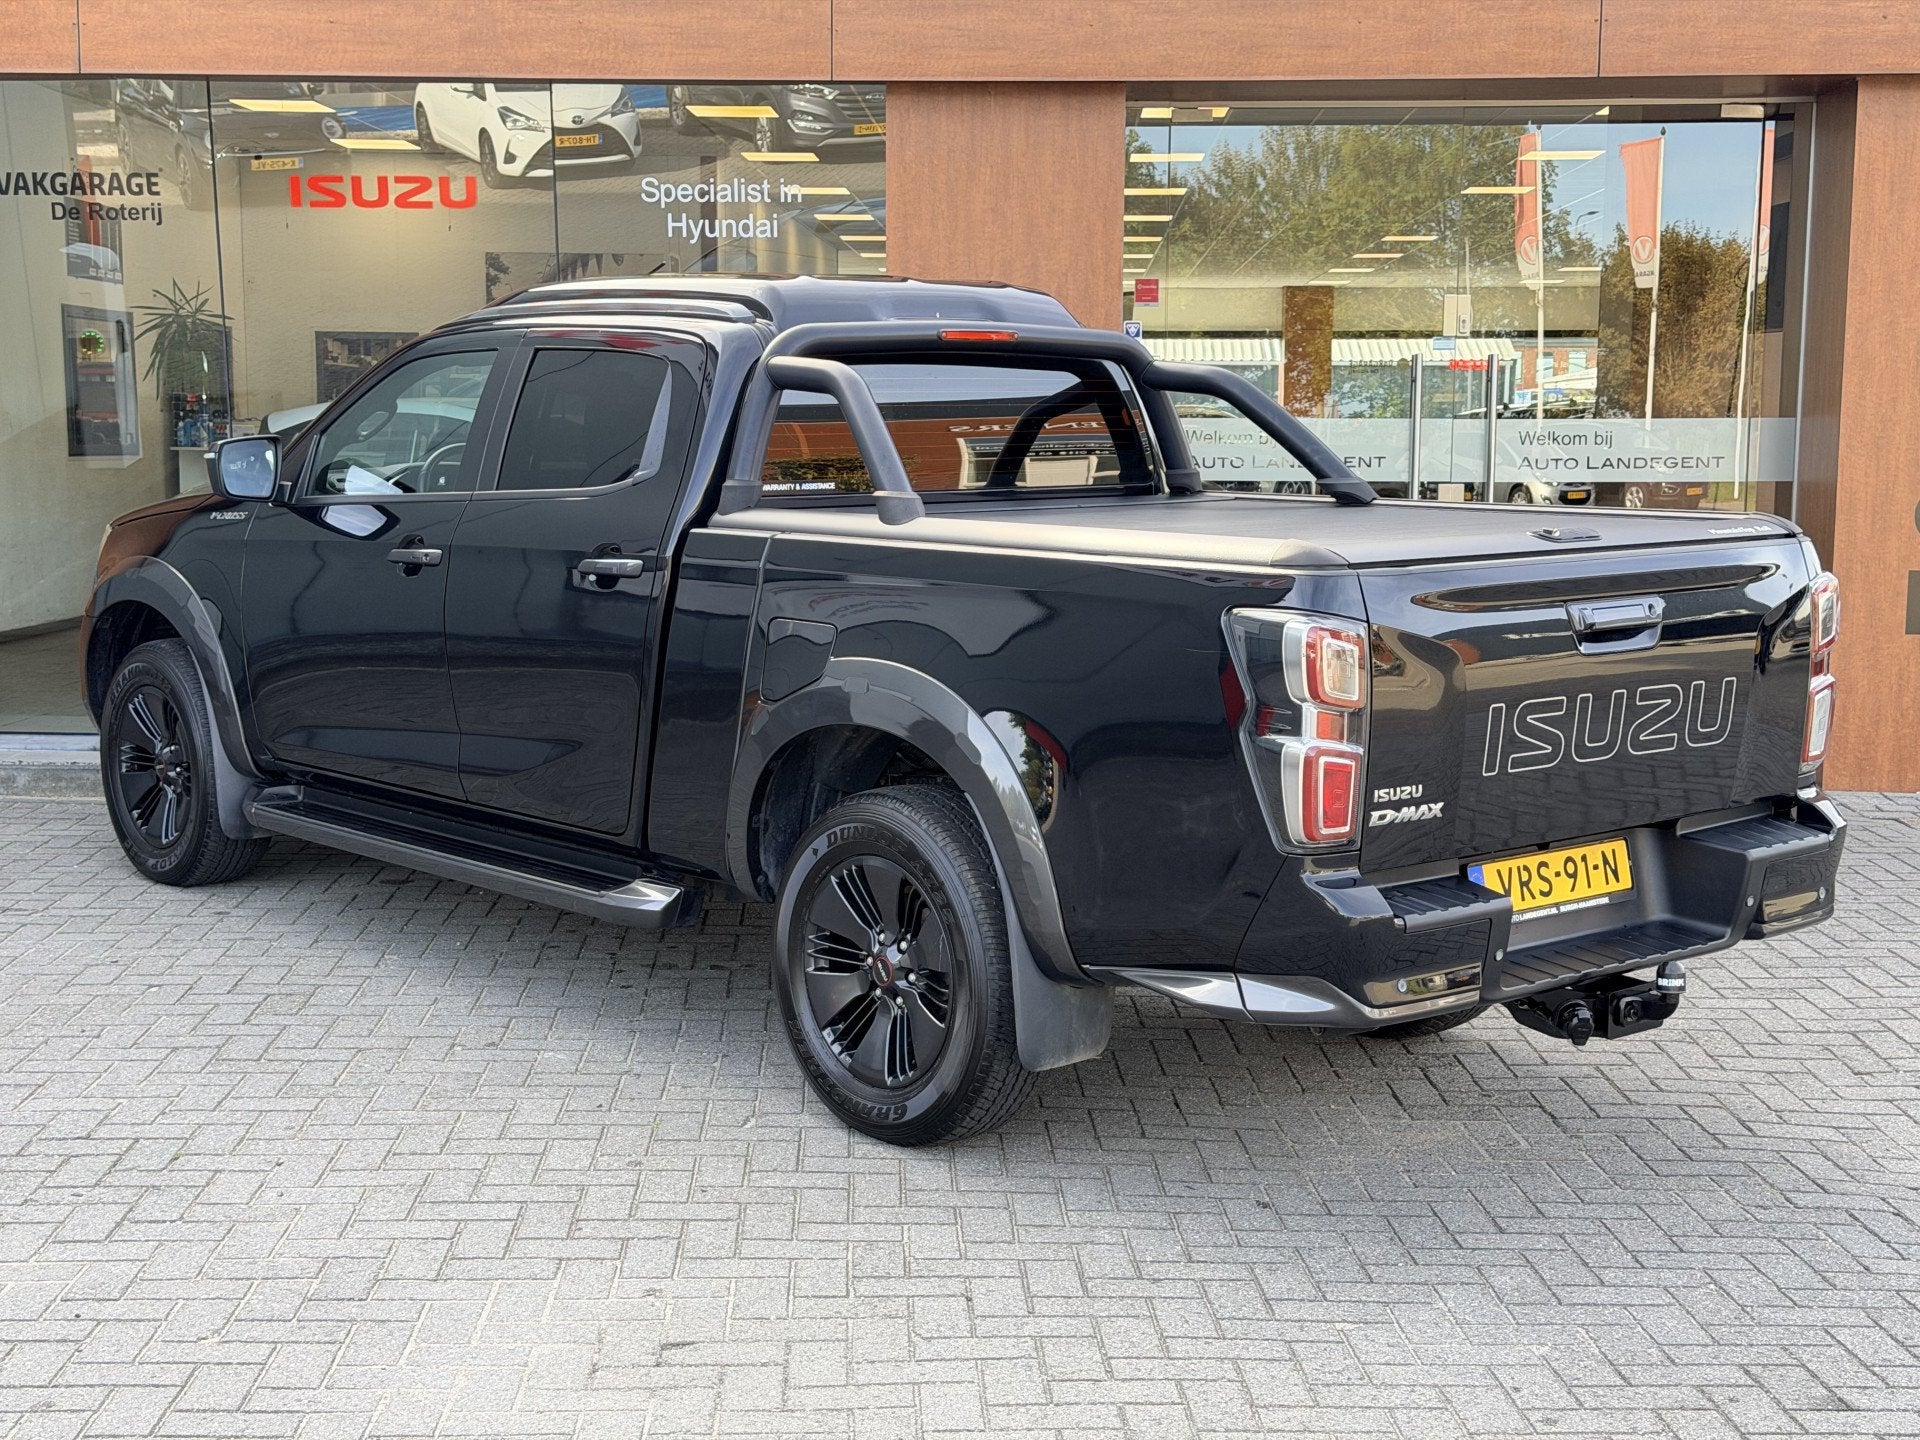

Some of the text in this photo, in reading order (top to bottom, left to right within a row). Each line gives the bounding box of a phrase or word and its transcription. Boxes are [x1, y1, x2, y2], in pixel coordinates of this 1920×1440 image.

[0, 171, 161, 196] VAKGARAGE
[289, 174, 478, 209] ISUZU
[640, 177, 802, 208] Specialist in
[51, 201, 163, 226] De Roterij
[667, 212, 778, 244] Hyundai
[1186, 429, 1253, 445] Welkom
[1518, 430, 1613, 449] Welkom bij
[1518, 455, 1726, 470] AUTO LANDEGENT
[801, 482, 836, 490] ASSISTANCE
[1482, 676, 1737, 776] ISUZU
[1373, 784, 1422, 803] ISUZU
[1496, 848, 1620, 902] VRS-91-N
[1657, 977, 1685, 987] BRINK
